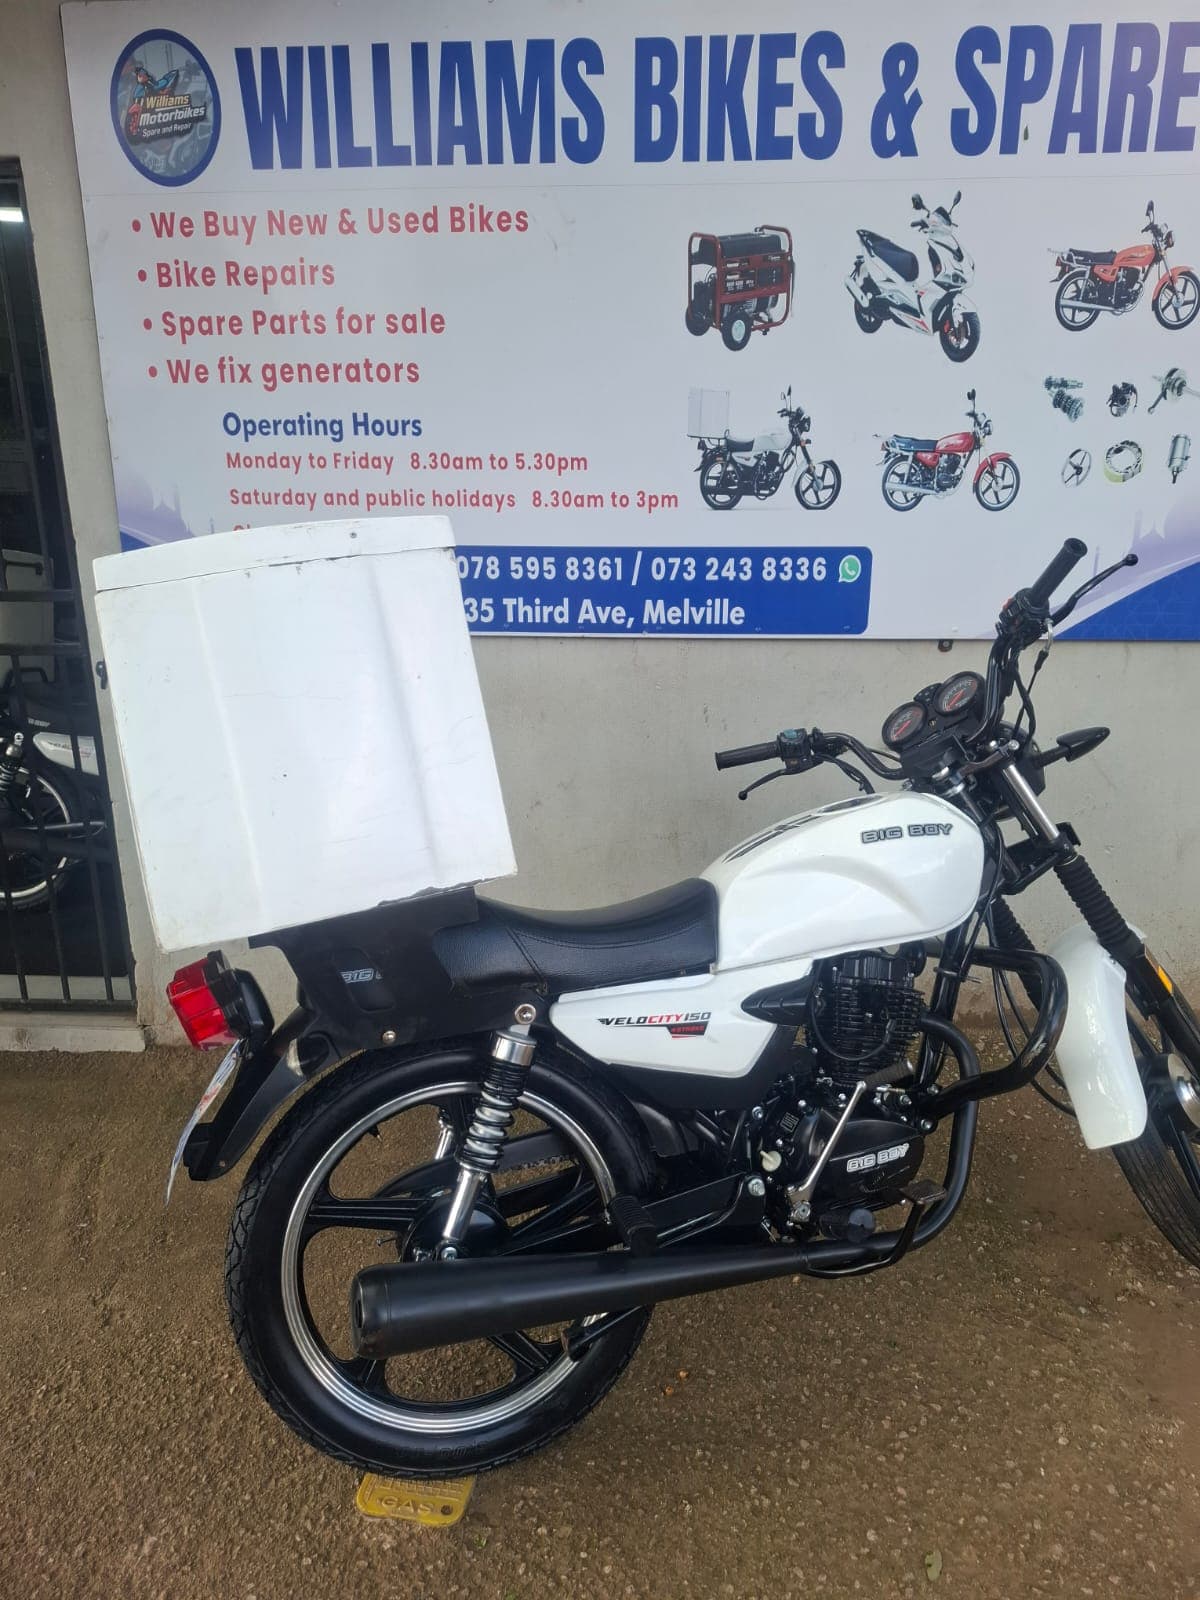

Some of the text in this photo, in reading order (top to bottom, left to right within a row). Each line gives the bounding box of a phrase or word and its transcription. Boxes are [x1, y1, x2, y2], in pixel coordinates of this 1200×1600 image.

[146, 95, 190, 108] Williams
[234, 21, 1200, 170] WILLIAMS BIKES & SPARE
[139, 106, 205, 126] Motorbikes
[142, 122, 192, 138] Spare and Repair
[151, 203, 529, 244] We Buy New & Used Bikes
[156, 257, 335, 294] Bike Repairs
[161, 307, 446, 344] Spare Parts for sale
[166, 356, 420, 392] We fix generators
[222, 411, 423, 442] Operating Hours
[226, 452, 588, 476] Monday to Friday 8.30am to 5.30pm
[229, 488, 679, 513] Saturday and public holidays 8.30am to 3pm
[456, 550, 827, 586] 078 595 8361 / 073 243 8336
[464, 596, 745, 628] 35 Third Ave, Melville
[861, 822, 953, 843] BIG BOY
[846, 1142, 910, 1173] BIG BOY
